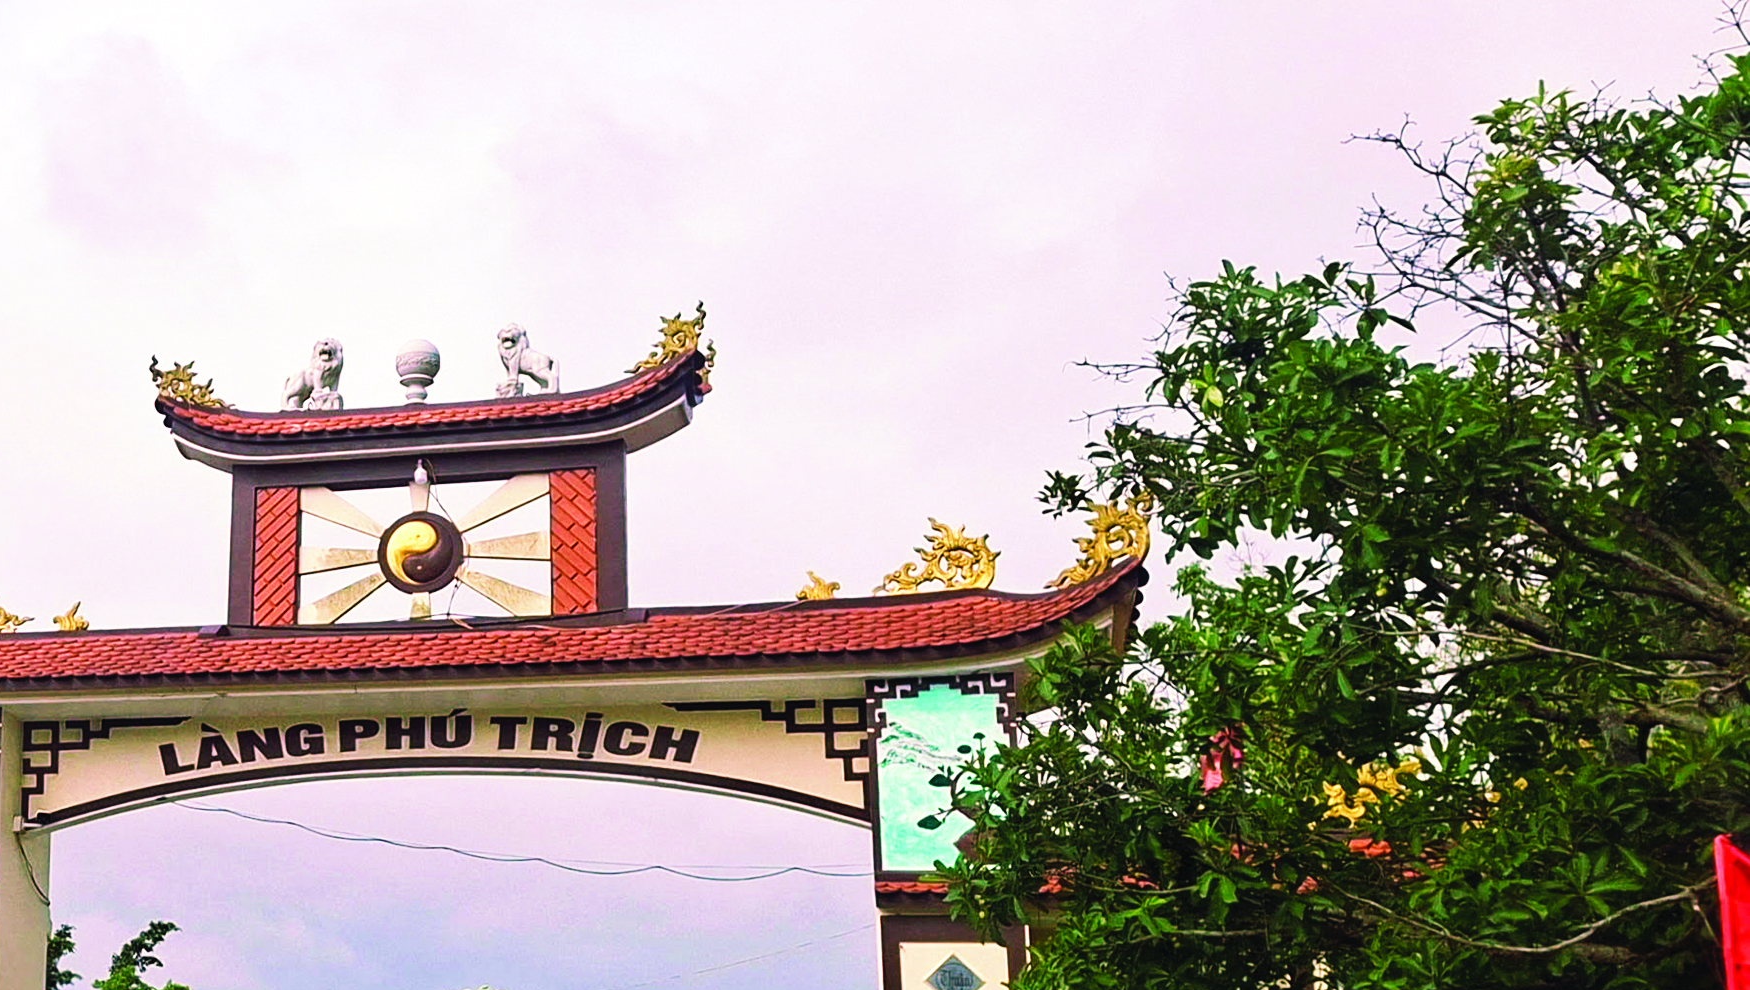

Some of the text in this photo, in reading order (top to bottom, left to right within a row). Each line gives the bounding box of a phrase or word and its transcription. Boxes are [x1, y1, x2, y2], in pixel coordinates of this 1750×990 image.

[158, 708, 700, 776] LÀNG PHÚ TRỊCH
